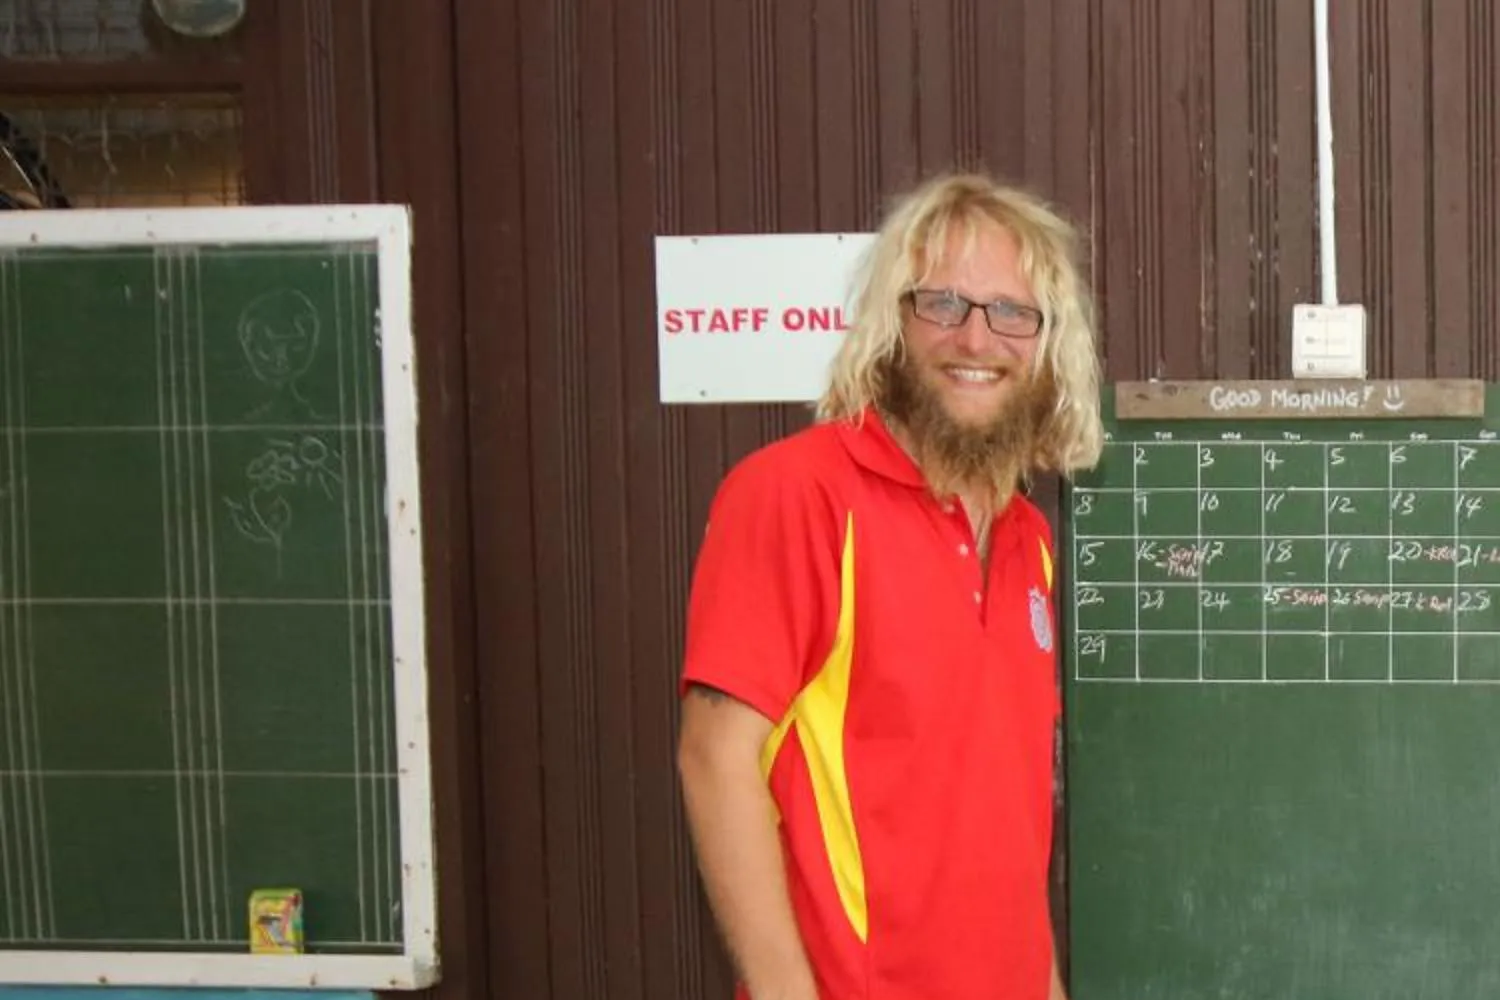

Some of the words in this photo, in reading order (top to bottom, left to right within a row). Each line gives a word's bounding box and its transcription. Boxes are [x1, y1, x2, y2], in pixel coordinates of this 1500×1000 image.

[664, 308, 769, 334] STAFF
[782, 306, 851, 332] ONL
[1136, 447, 1149, 466] 2
[1200, 447, 1215, 468] 3
[1264, 448, 1285, 472] 4
[1330, 447, 1345, 466] 5
[1391, 446, 1407, 464] 6
[1459, 445, 1478, 471] 7
[1075, 494, 1093, 516] 8
[1136, 490, 1148, 517] 9
[1200, 492, 1220, 512] 10
[1265, 493, 1285, 513] 11
[1328, 495, 1358, 514] 12
[1391, 491, 1416, 516] 13
[1456, 494, 1483, 518] 14
[1079, 541, 1105, 566] 15
[1265, 540, 1294, 564] 18
[1327, 541, 1351, 571] 19
[1388, 541, 1423, 562] 20
[1457, 543, 1482, 568] 21
[1200, 591, 1231, 612] 24
[1080, 633, 1107, 664] 29
